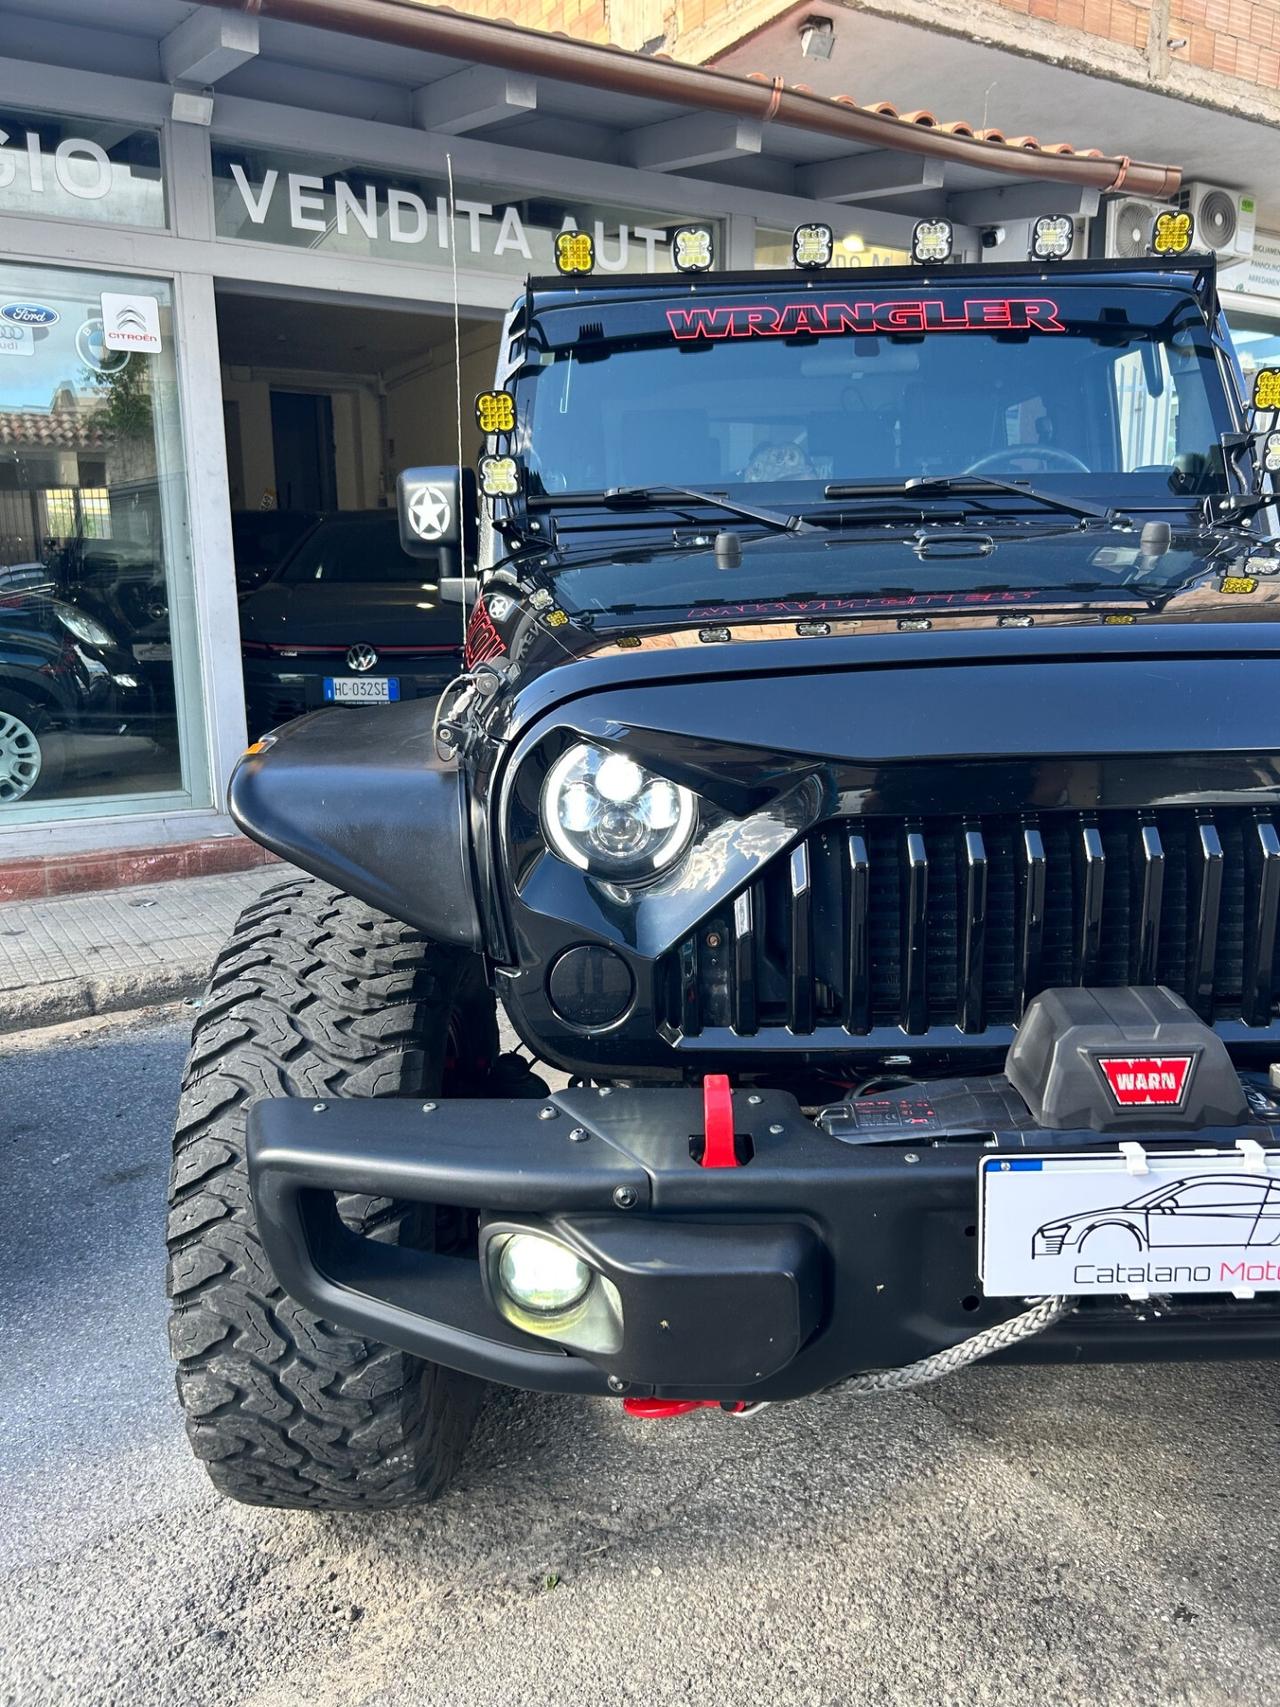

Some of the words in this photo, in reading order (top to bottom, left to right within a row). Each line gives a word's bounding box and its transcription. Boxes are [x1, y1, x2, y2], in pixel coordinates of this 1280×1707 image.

[229, 163, 533, 260] VENDITA
[13, 306, 47, 322] Ford
[666, 299, 1066, 340] WRANGLER
[1115, 1072, 1176, 1091] WARN
[1073, 1262, 1211, 1284] Catalano
[1219, 1260, 1280, 1283] Mot
